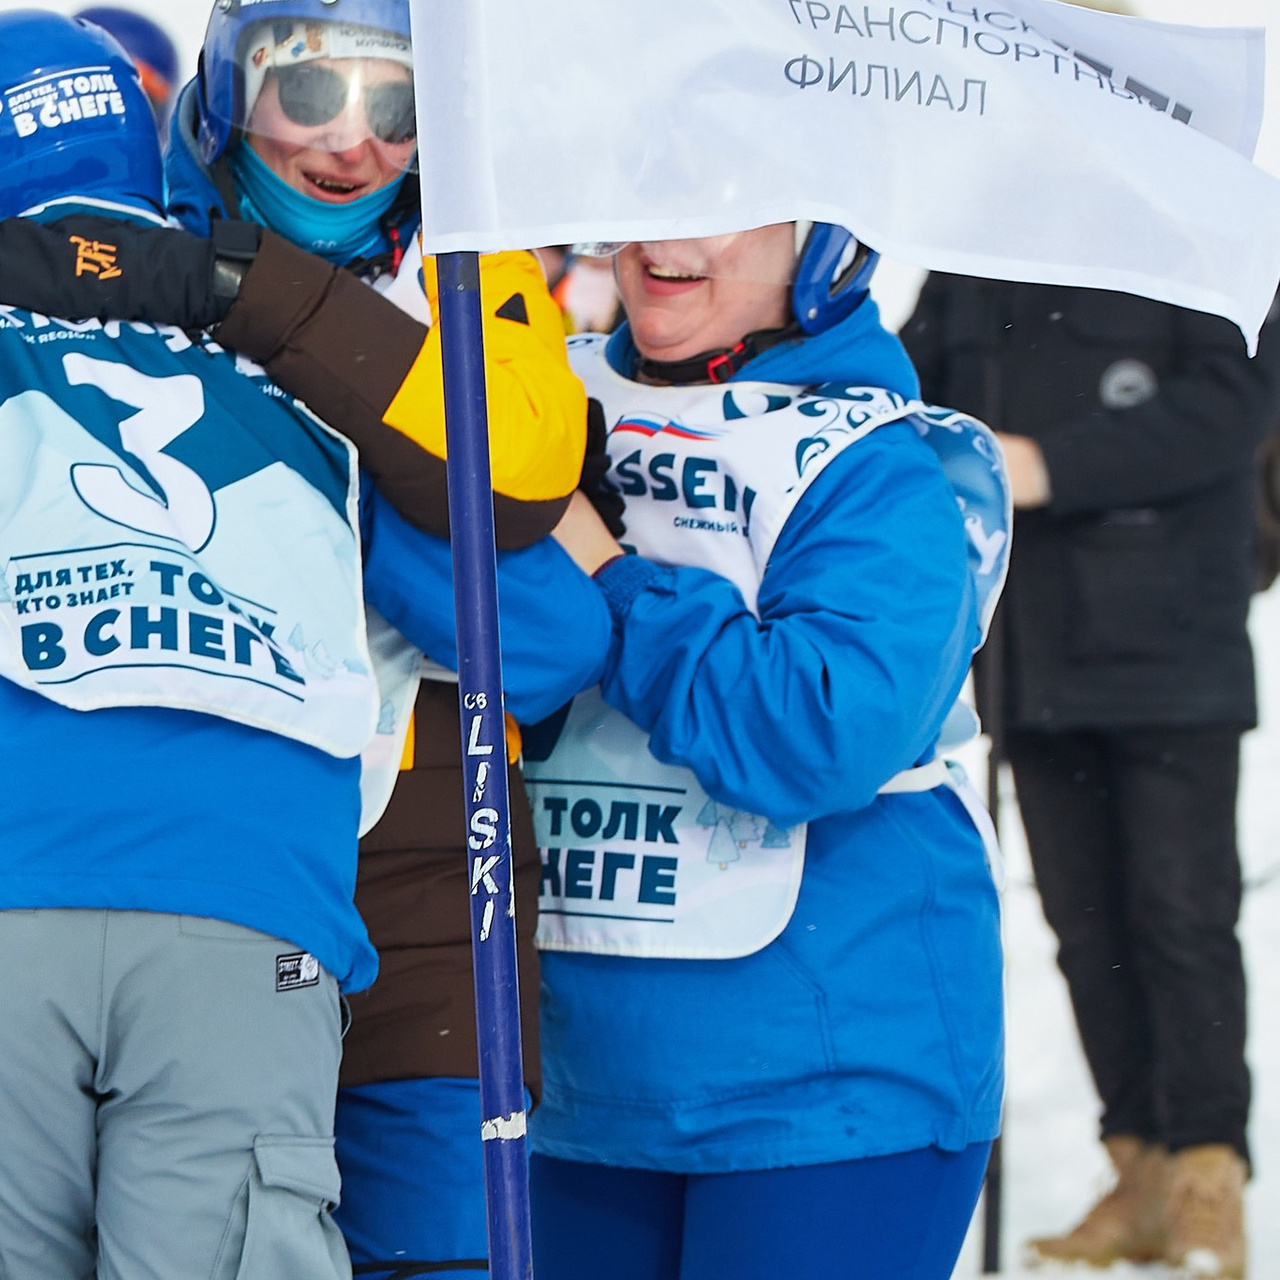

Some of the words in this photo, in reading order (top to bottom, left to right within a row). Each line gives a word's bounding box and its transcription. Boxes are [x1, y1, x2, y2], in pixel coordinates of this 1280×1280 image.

[58, 74, 119, 97] ТОЛК
[783, 53, 988, 116] ФИЛИАЛ
[14, 112, 38, 138] В
[39, 92, 126, 128] СНЕГЕ
[62, 352, 216, 554] 3
[673, 516, 739, 535] СНЕЖНЫЙ
[14, 570, 71, 595] ДЛЯ
[77, 559, 135, 584] ТЕХ,
[16, 594, 61, 615] КТО
[66, 582, 135, 607] ЗНАЕТ
[20, 621, 67, 670] В
[467, 715, 501, 942] LISKI
[542, 796, 683, 845] ТОЛК
[538, 846, 678, 906] НЕГЕ
